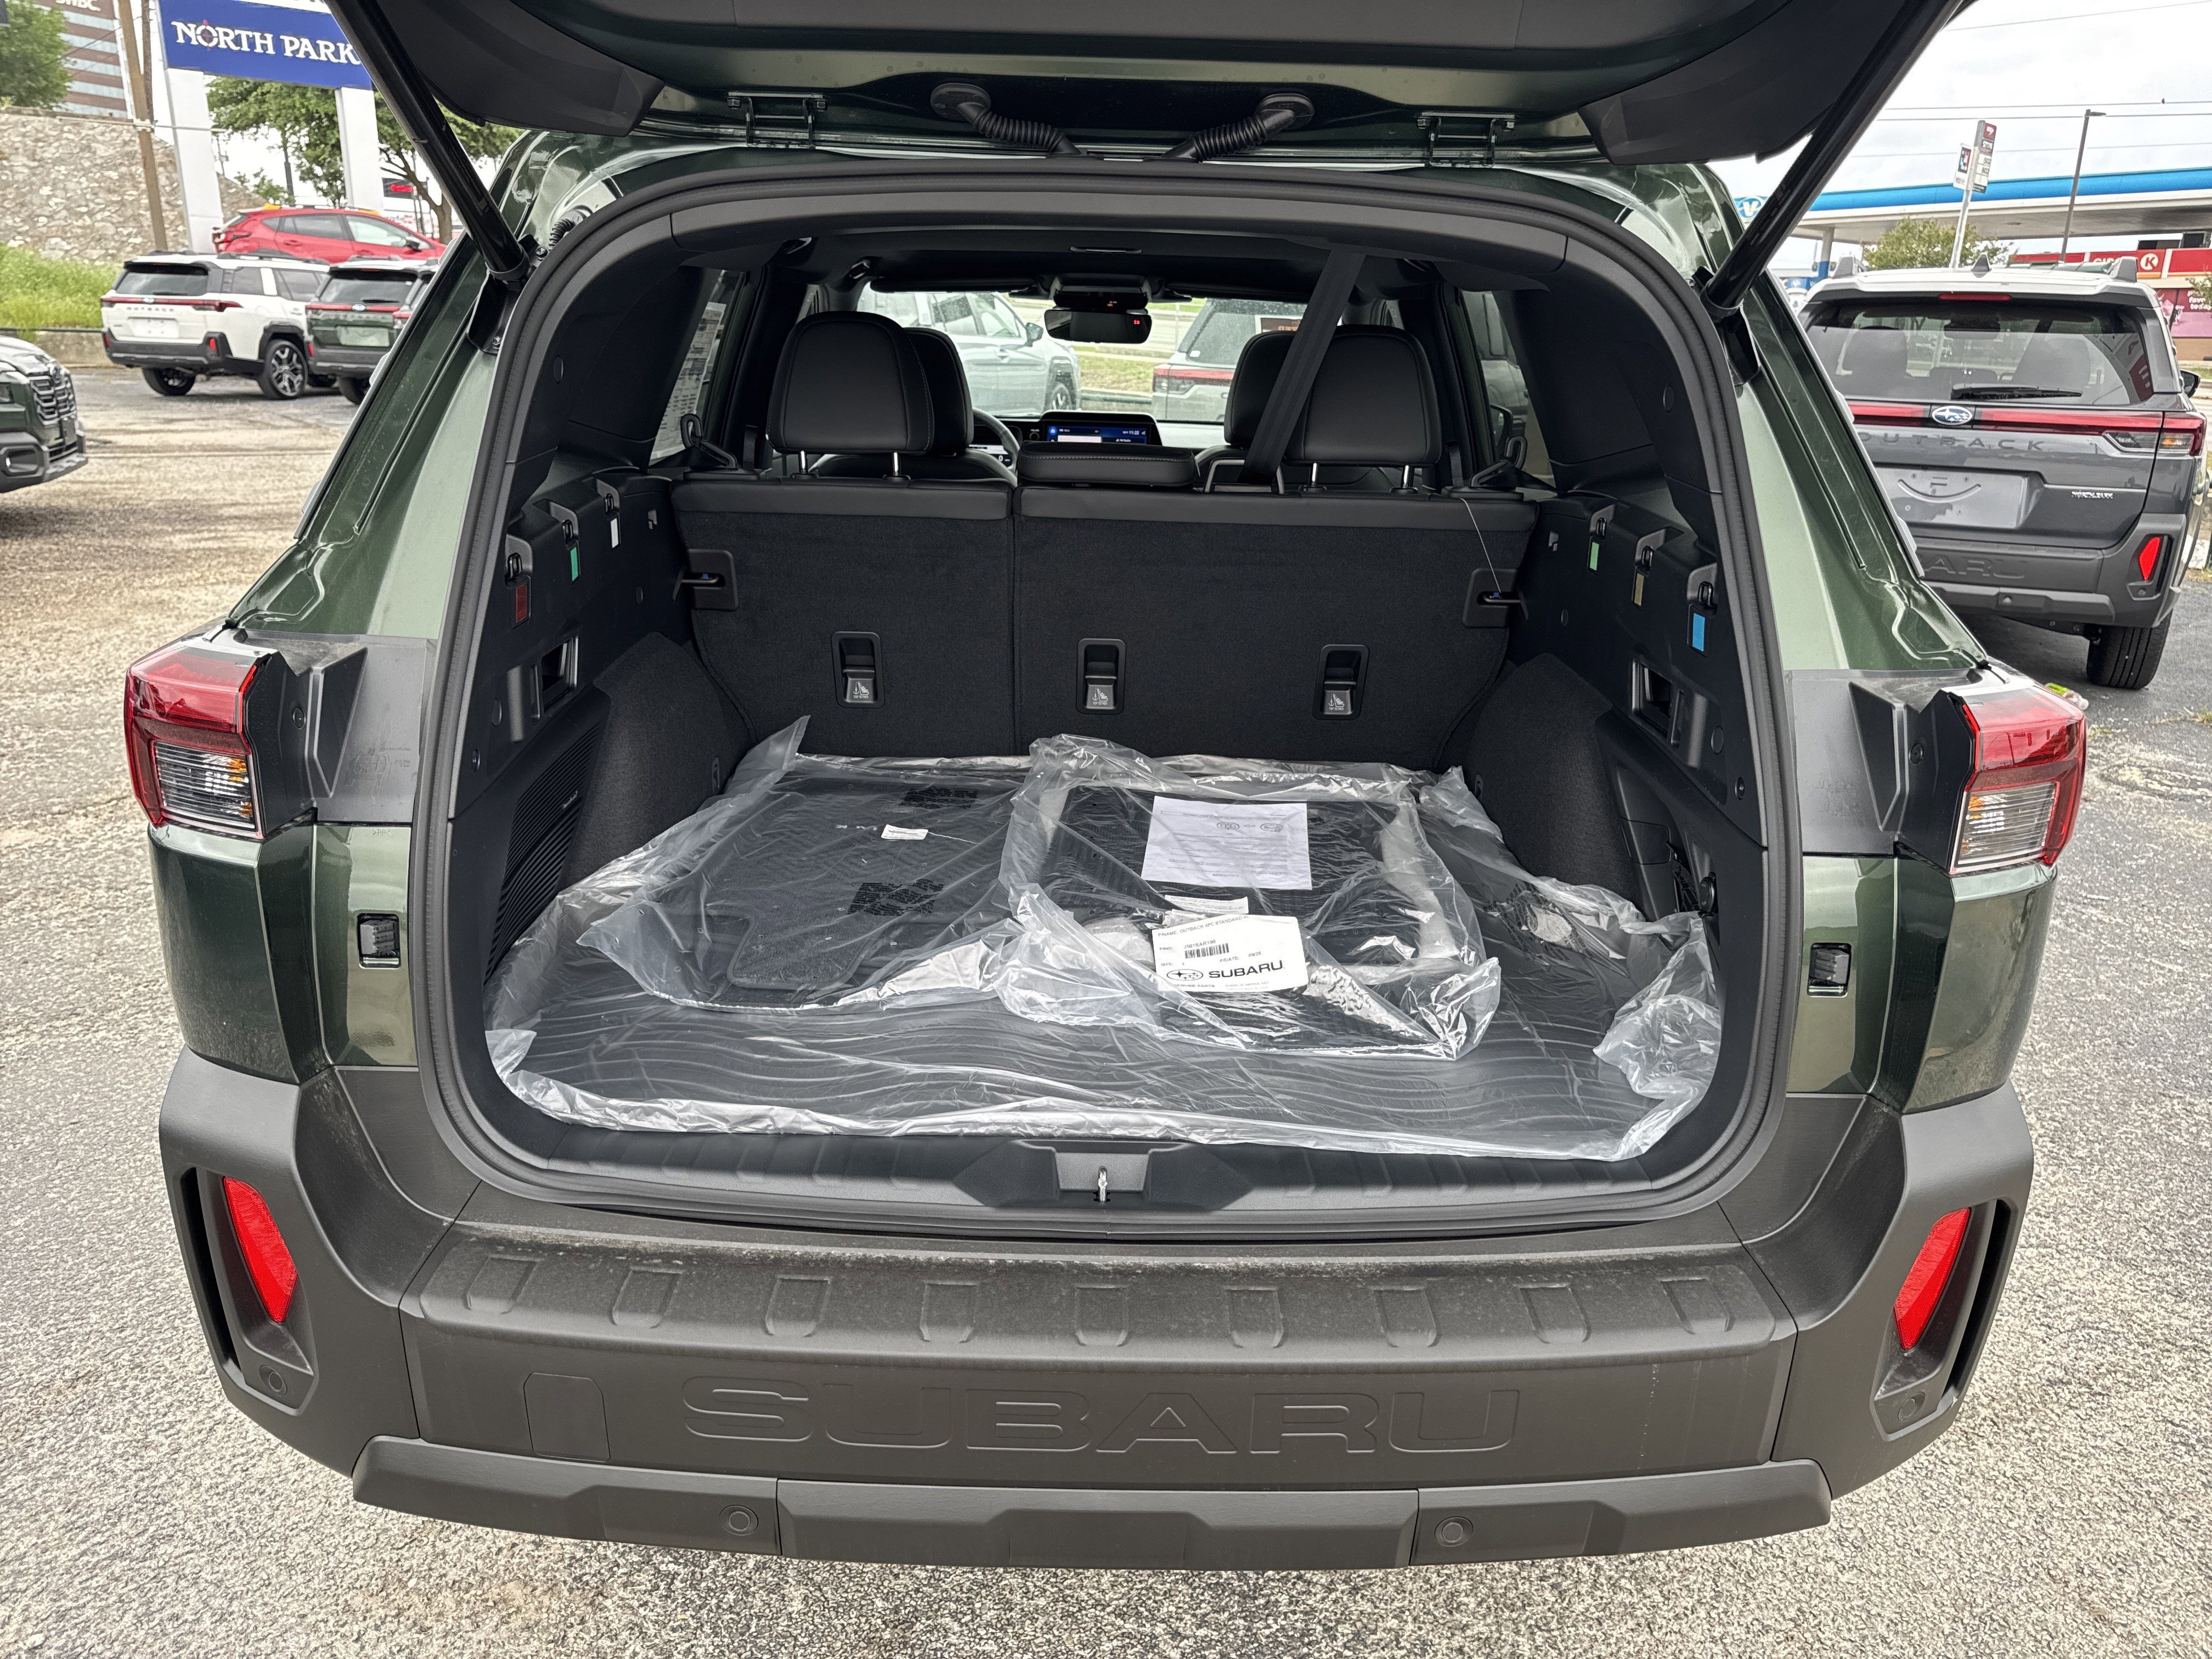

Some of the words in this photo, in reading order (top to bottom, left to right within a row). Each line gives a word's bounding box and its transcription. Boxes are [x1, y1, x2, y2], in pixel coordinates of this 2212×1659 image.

[171, 21, 275, 55] NORTH
[280, 35, 360, 65] PARK
[1855, 432, 2045, 451] OUTBACK
[1923, 555, 2025, 580] ARU
[1180, 924, 1204, 933] OUTBACK
[1209, 960, 1283, 978] SUBARU
[683, 1374, 1520, 1457] SUBARU
